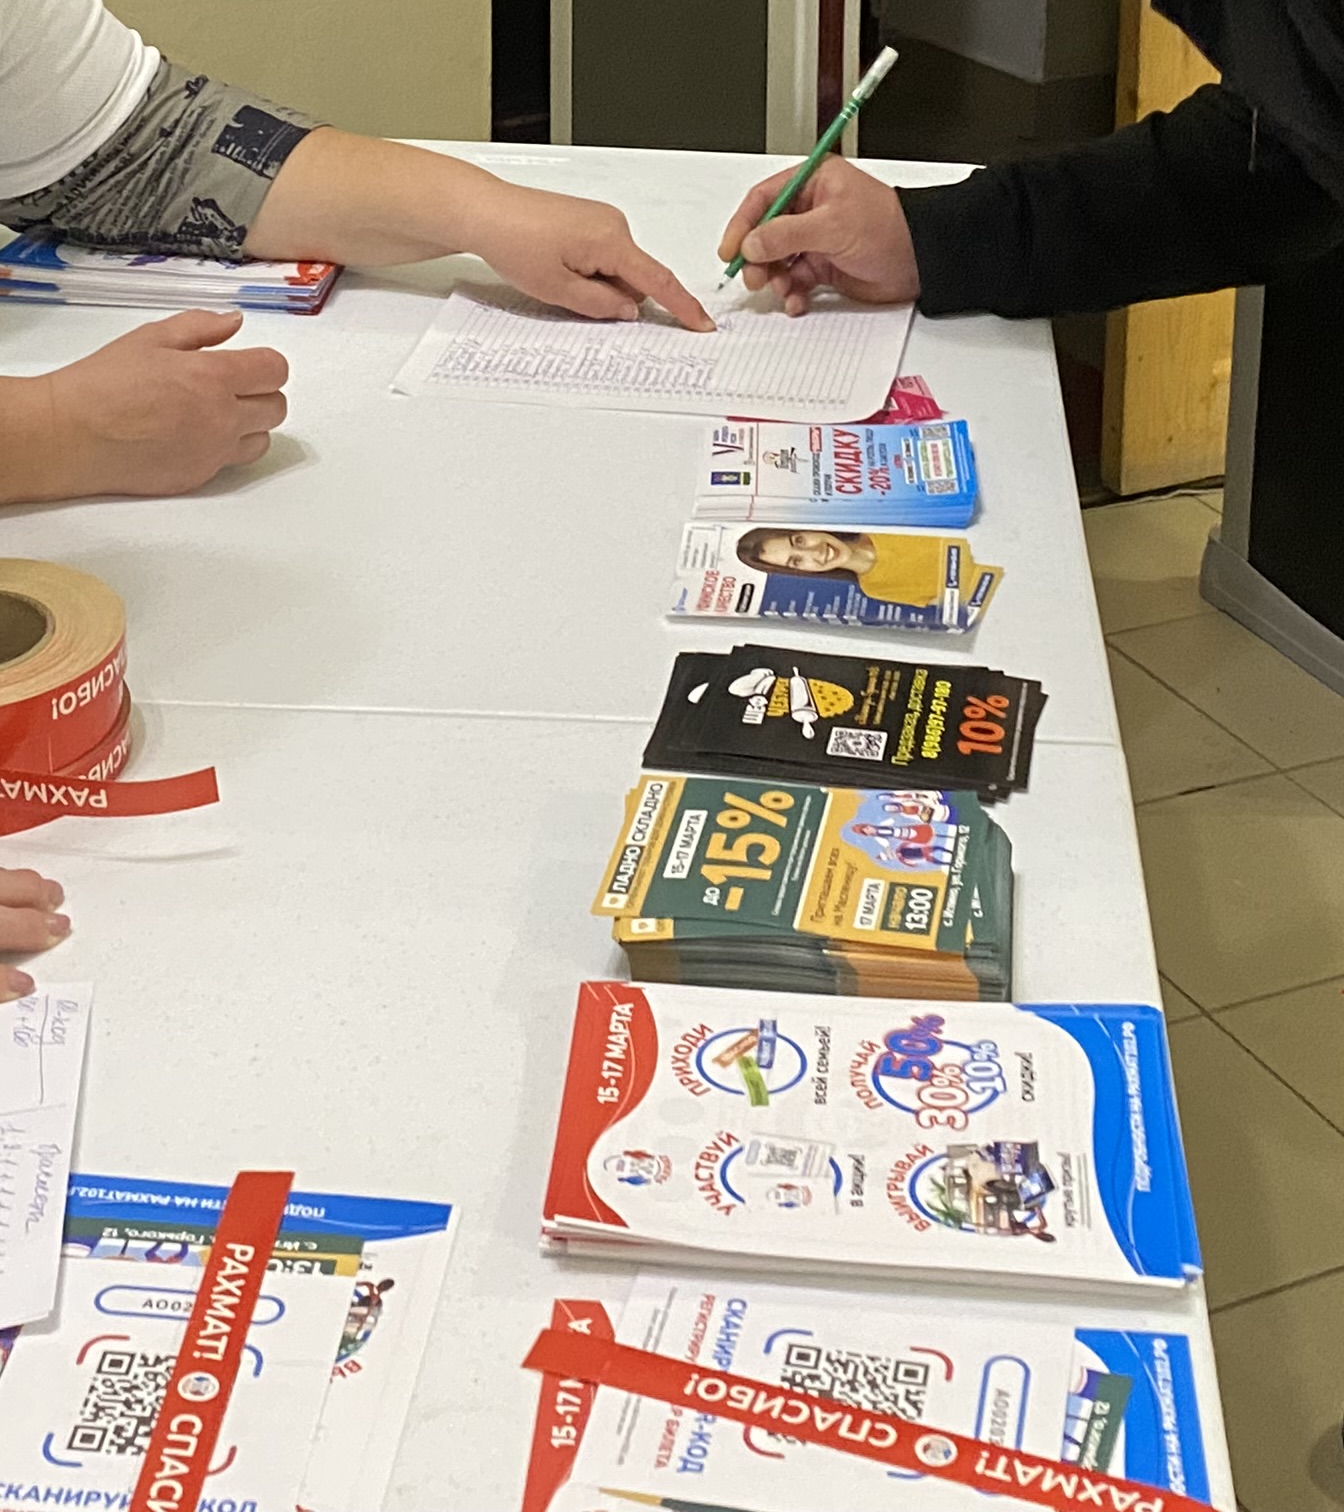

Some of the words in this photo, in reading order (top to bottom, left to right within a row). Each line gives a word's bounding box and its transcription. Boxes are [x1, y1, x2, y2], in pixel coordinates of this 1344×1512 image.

[833, 427, 864, 495] СКИДКУ
[957, 694, 1010, 756] 10%
[613, 846, 641, 894] ЛАДНО
[632, 782, 663, 842] СКЛАДНО
[684, 813, 702, 850] МАРТА
[701, 790, 795, 911] -15%
[862, 881, 881, 916] МАРТА
[905, 888, 934, 930] 13:00
[606, 1002, 634, 1059] МАРТА
[672, 1023, 714, 1097] ПРИХОДИ
[874, 1013, 946, 1082] 50%
[597, 1059, 624, 1104] 15-17
[815, 1076, 828, 1105] всей
[849, 1039, 883, 1110] ПОЛУЧАЙ
[916, 1062, 969, 1131] 30%
[963, 1039, 1007, 1094] 10%
[71, 1186, 171, 1207] РАХМАТ102.
[694, 1130, 741, 1216] УЧАСТВУЙ
[886, 1143, 935, 1233] ВЫИГРЫВАЙ
[192, 1242, 255, 1361] РАХМАТ!
[712, 1297, 748, 1373] СКАНИР
[550, 1390, 582, 1448] 15-17
[683, 1370, 900, 1450] СПАСИБО!
